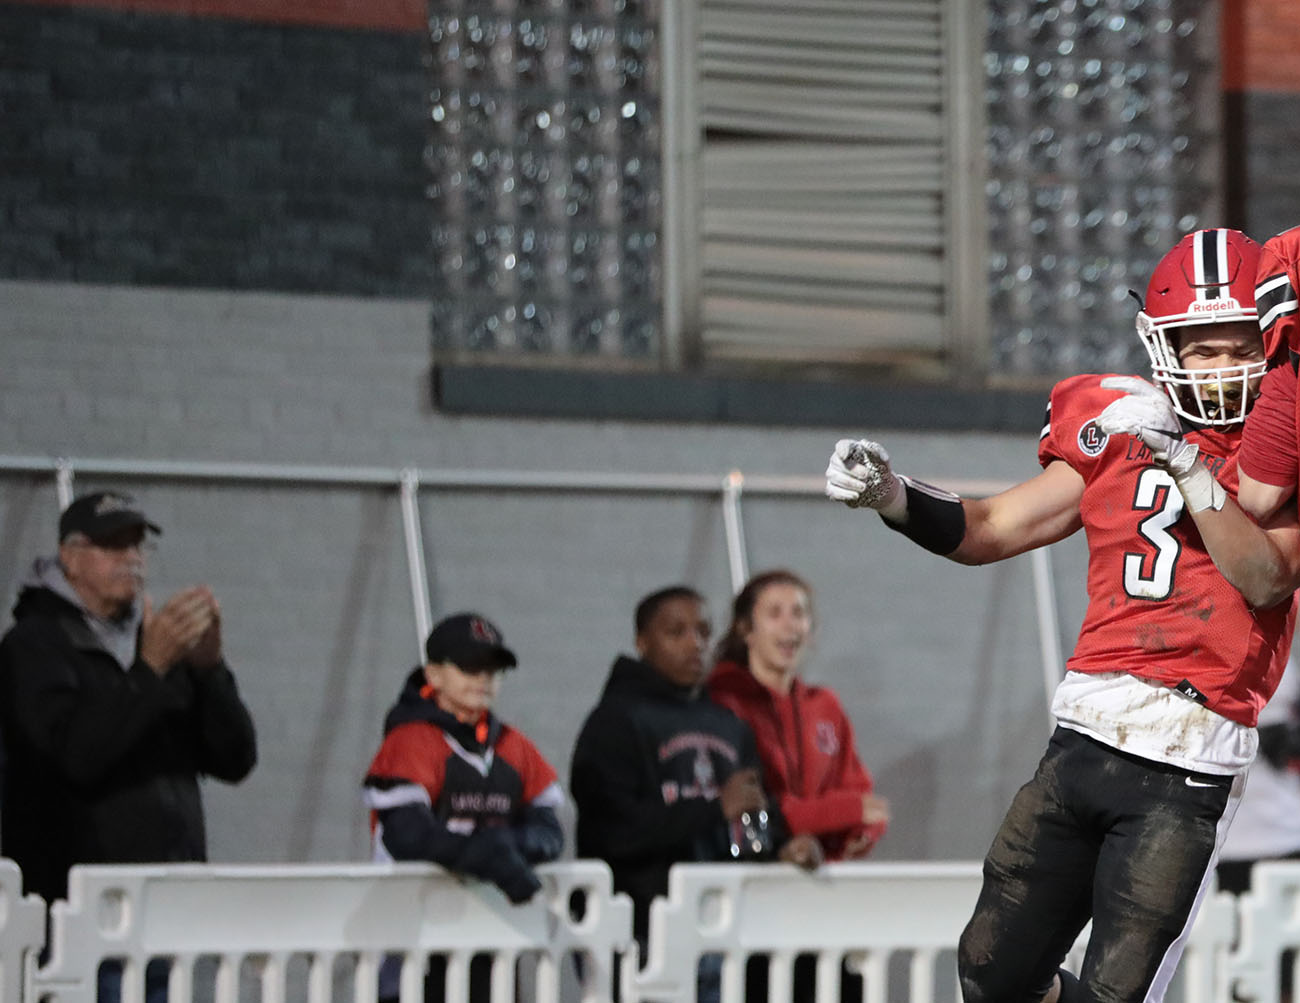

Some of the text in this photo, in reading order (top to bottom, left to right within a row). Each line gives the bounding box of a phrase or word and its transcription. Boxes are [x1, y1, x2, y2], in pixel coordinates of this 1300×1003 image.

[1193, 300, 1235, 313] Riddell
[1086, 427, 1099, 447] L
[1121, 466, 1185, 601] 3
